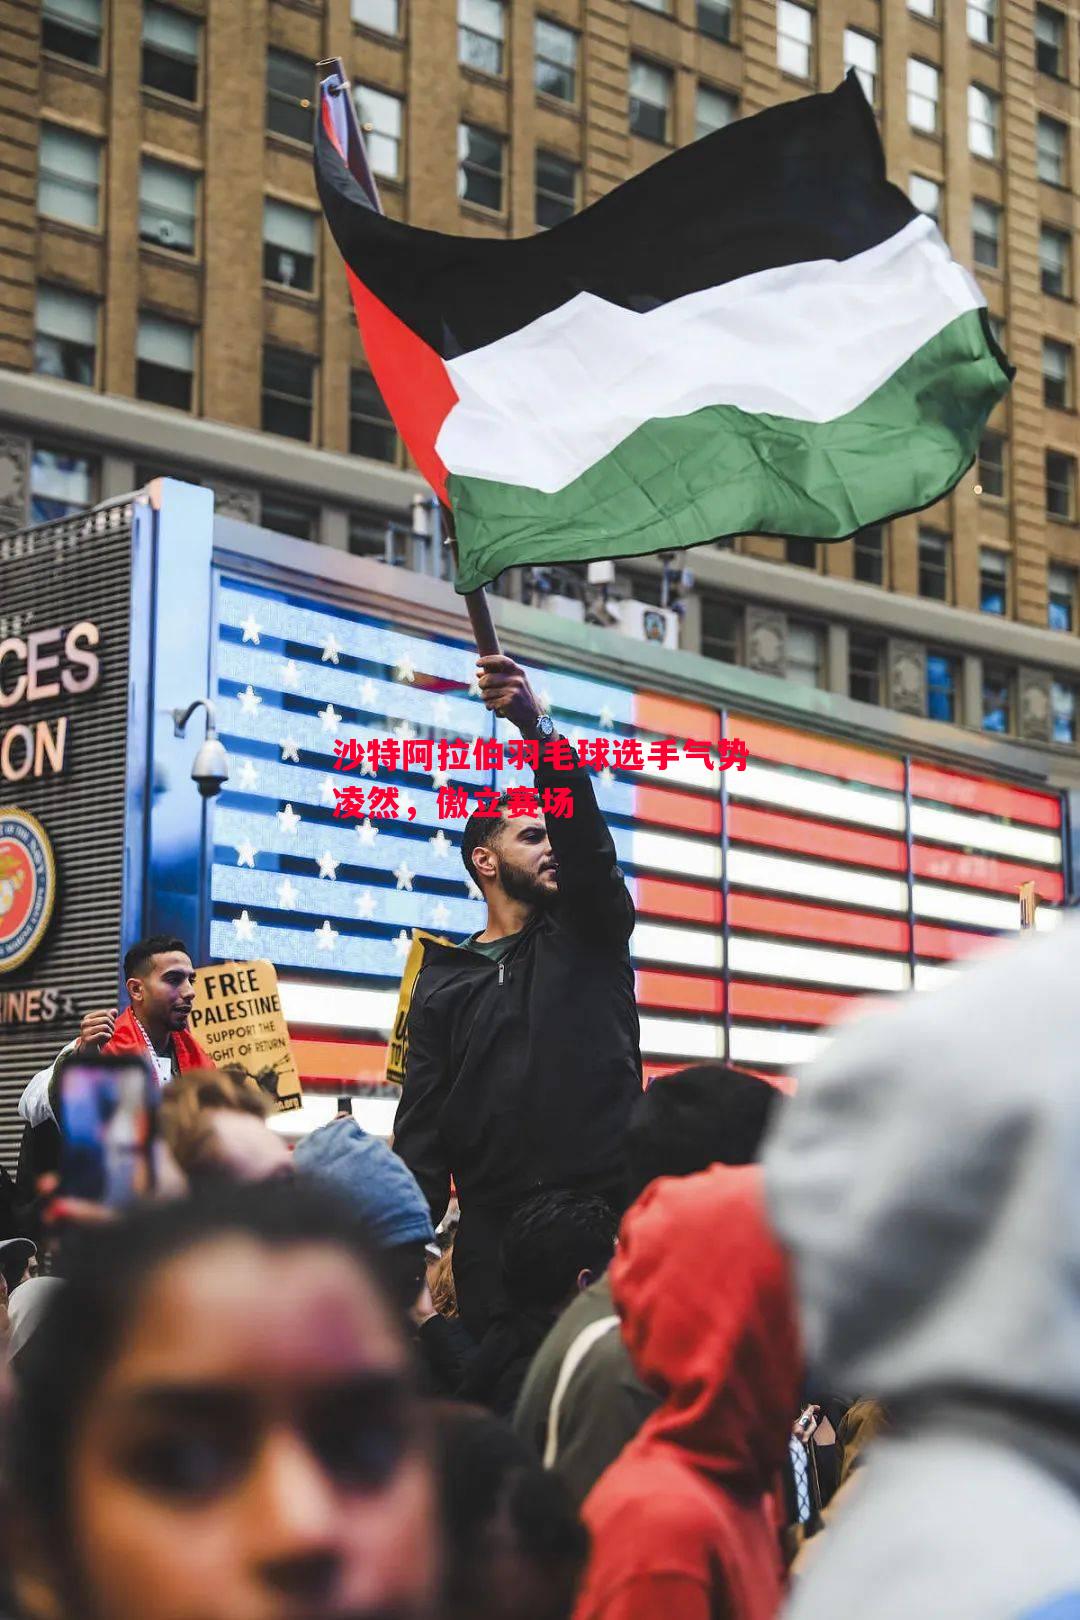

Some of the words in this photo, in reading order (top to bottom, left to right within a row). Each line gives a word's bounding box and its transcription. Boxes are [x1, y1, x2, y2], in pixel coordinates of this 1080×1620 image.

[0, 621, 100, 708] CES
[204, 969, 260, 1000] FREE
[0, 986, 59, 1025] INES
[191, 994, 281, 1028] PALESTINE
[206, 1025, 256, 1044] SUPPORT
[258, 1021, 276, 1033] THE
[238, 1044, 252, 1056] OF
[255, 1037, 286, 1053] RETURN
